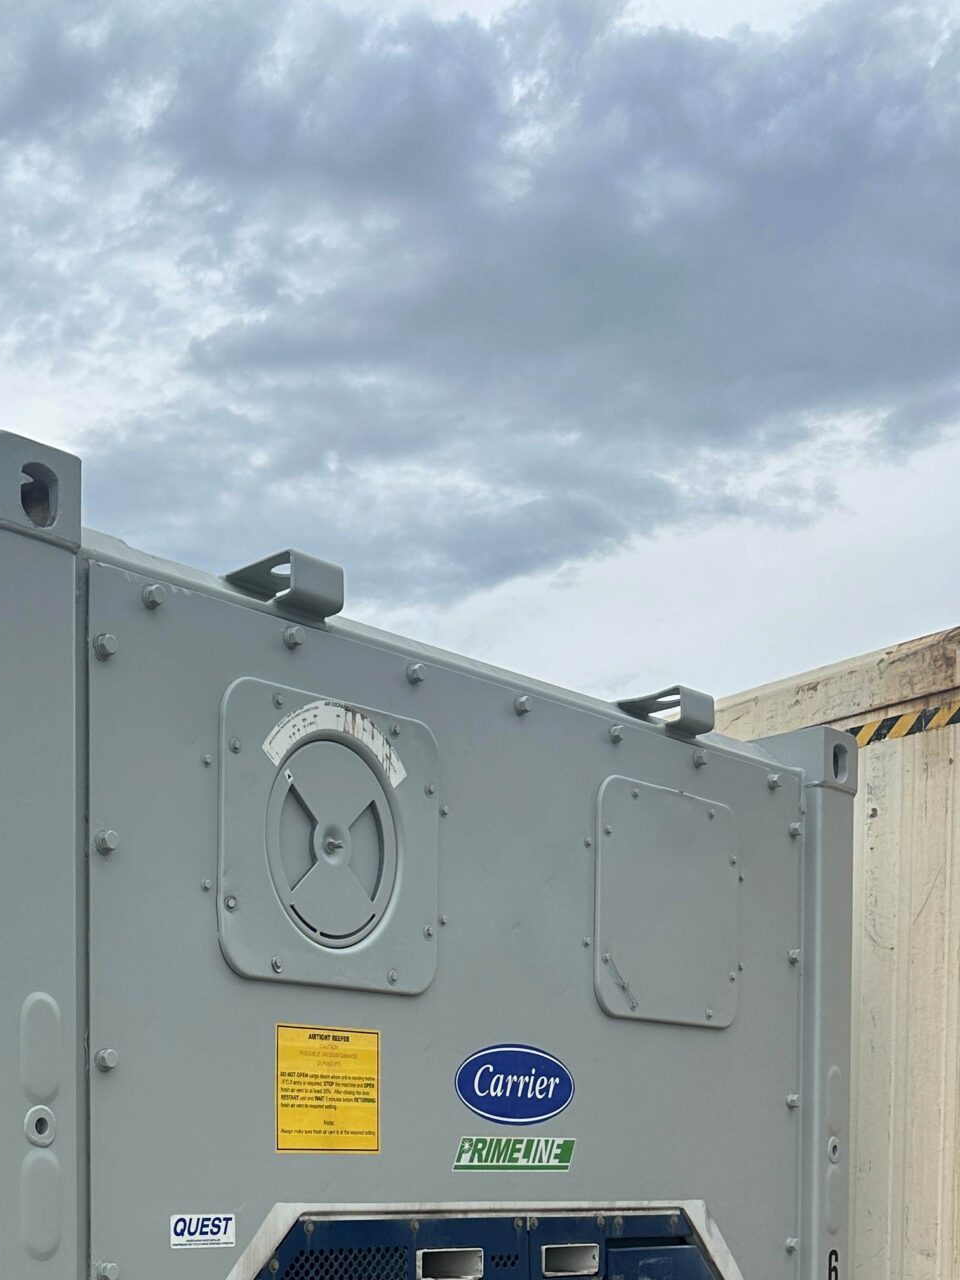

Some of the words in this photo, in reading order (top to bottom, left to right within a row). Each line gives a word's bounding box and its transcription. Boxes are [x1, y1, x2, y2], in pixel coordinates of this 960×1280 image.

[474, 1064, 559, 1099] Carrier
[455, 1138, 571, 1164] PRIMELINE
[173, 1217, 233, 1237] QUEST
